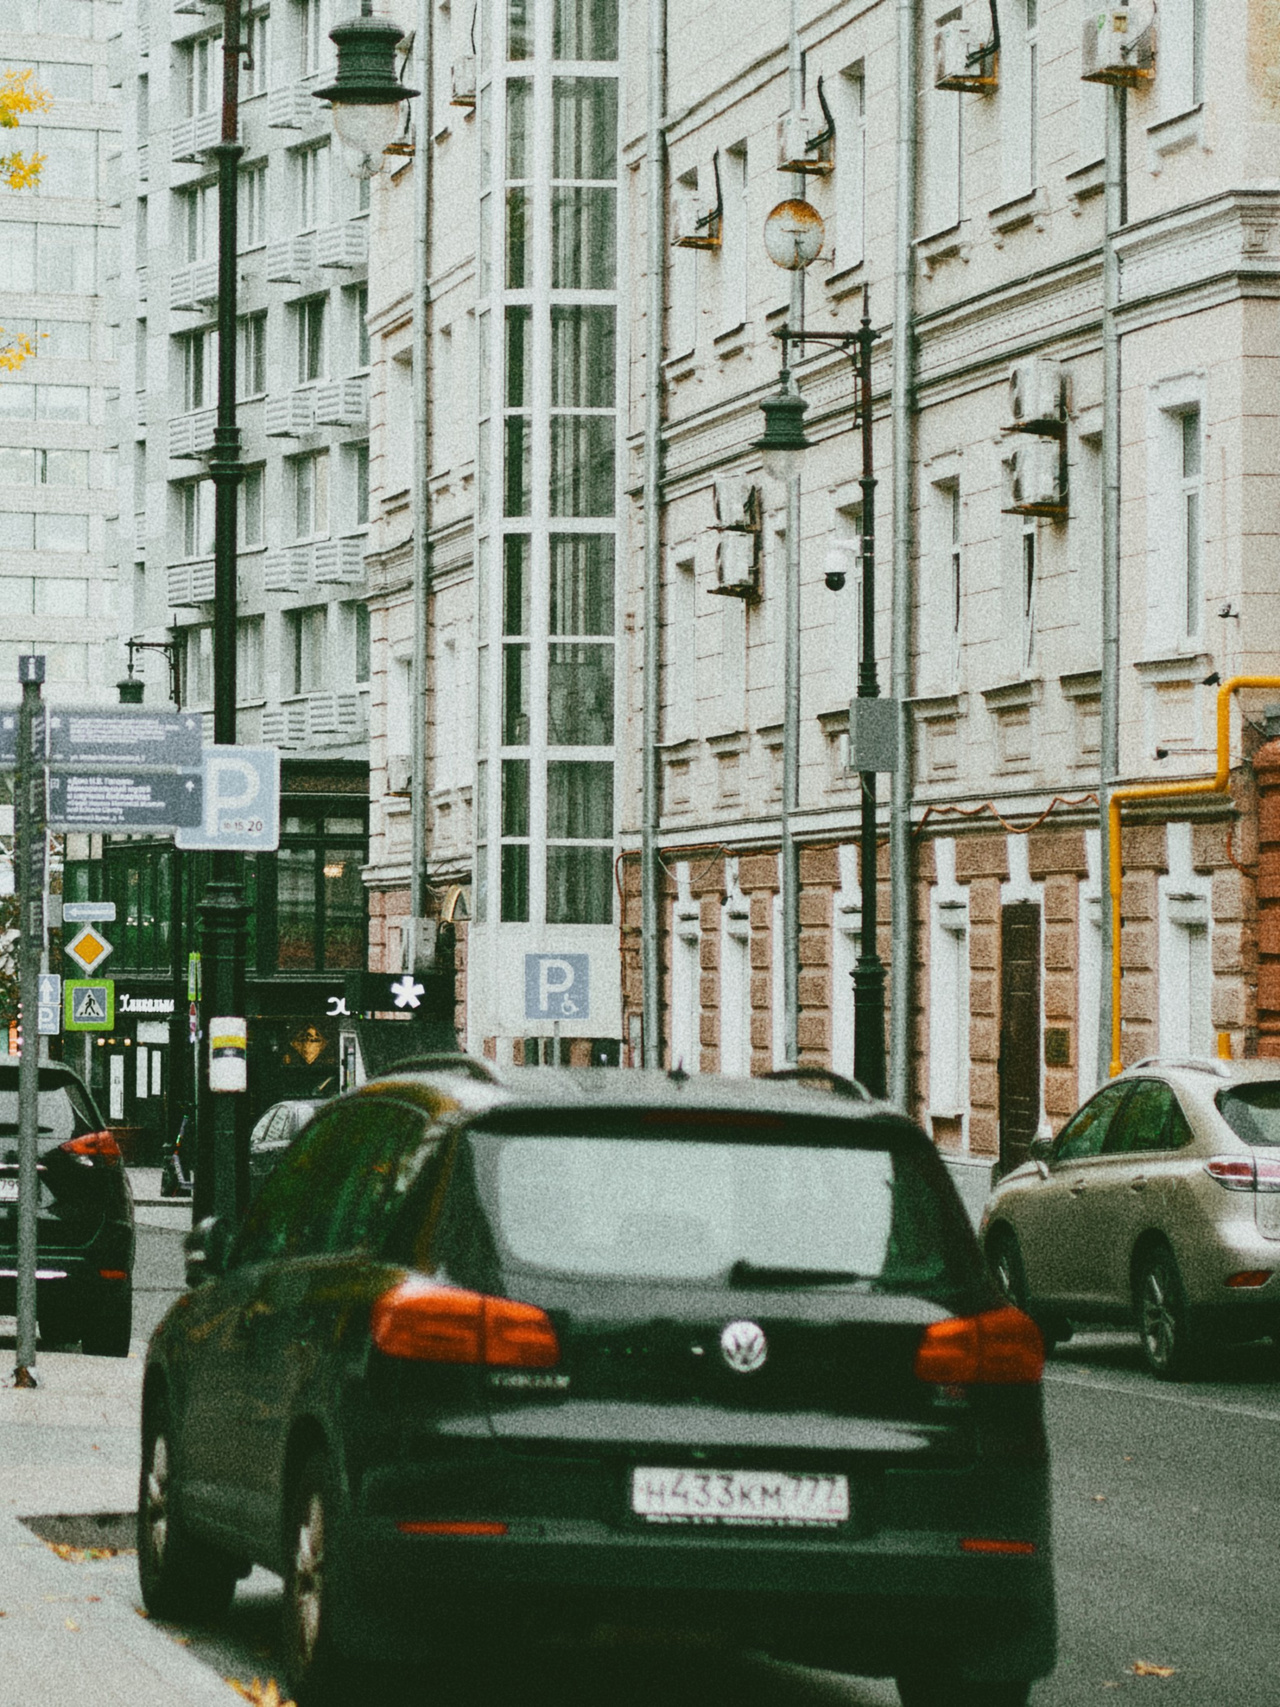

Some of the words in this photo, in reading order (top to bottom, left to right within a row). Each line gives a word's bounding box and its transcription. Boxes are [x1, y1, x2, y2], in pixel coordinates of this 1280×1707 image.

[206, 757, 260, 837] P
[234, 821, 244, 831] 15
[247, 820, 263, 832] 20
[538, 958, 575, 1011] P
